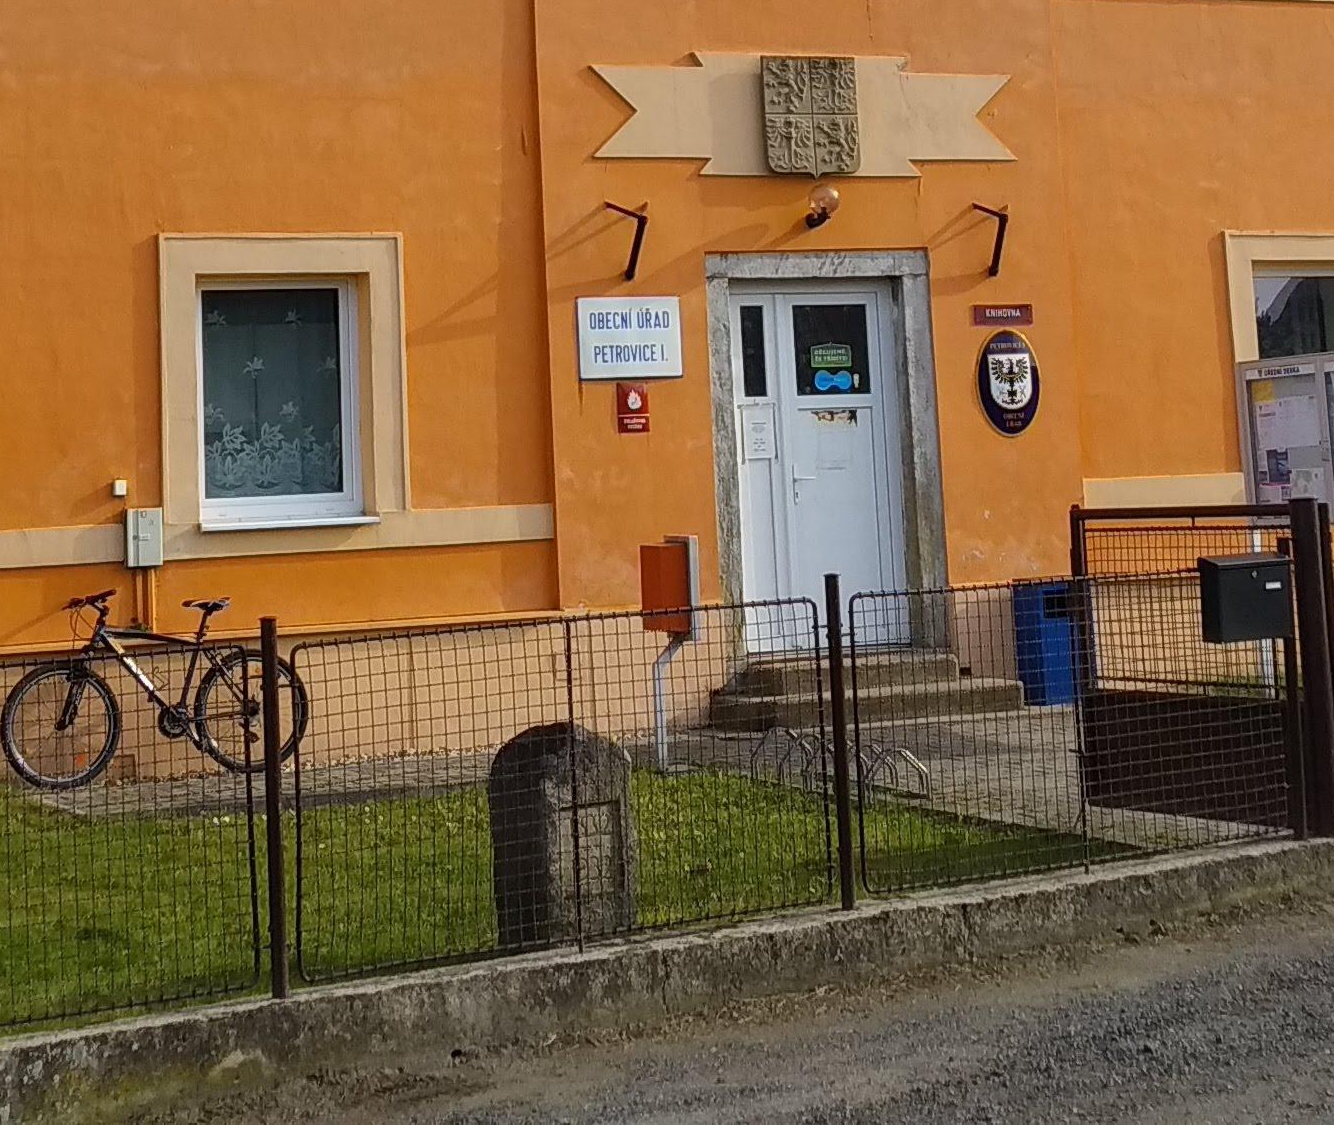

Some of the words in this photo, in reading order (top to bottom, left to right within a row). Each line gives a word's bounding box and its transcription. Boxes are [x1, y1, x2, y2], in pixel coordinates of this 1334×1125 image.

[589, 308, 632, 330] OBECNÍ
[637, 308, 670, 329] ÚŘAD
[985, 308, 1021, 318] KNIHOVNA
[594, 344, 657, 363] PETROVICE
[660, 344, 669, 362] I.
